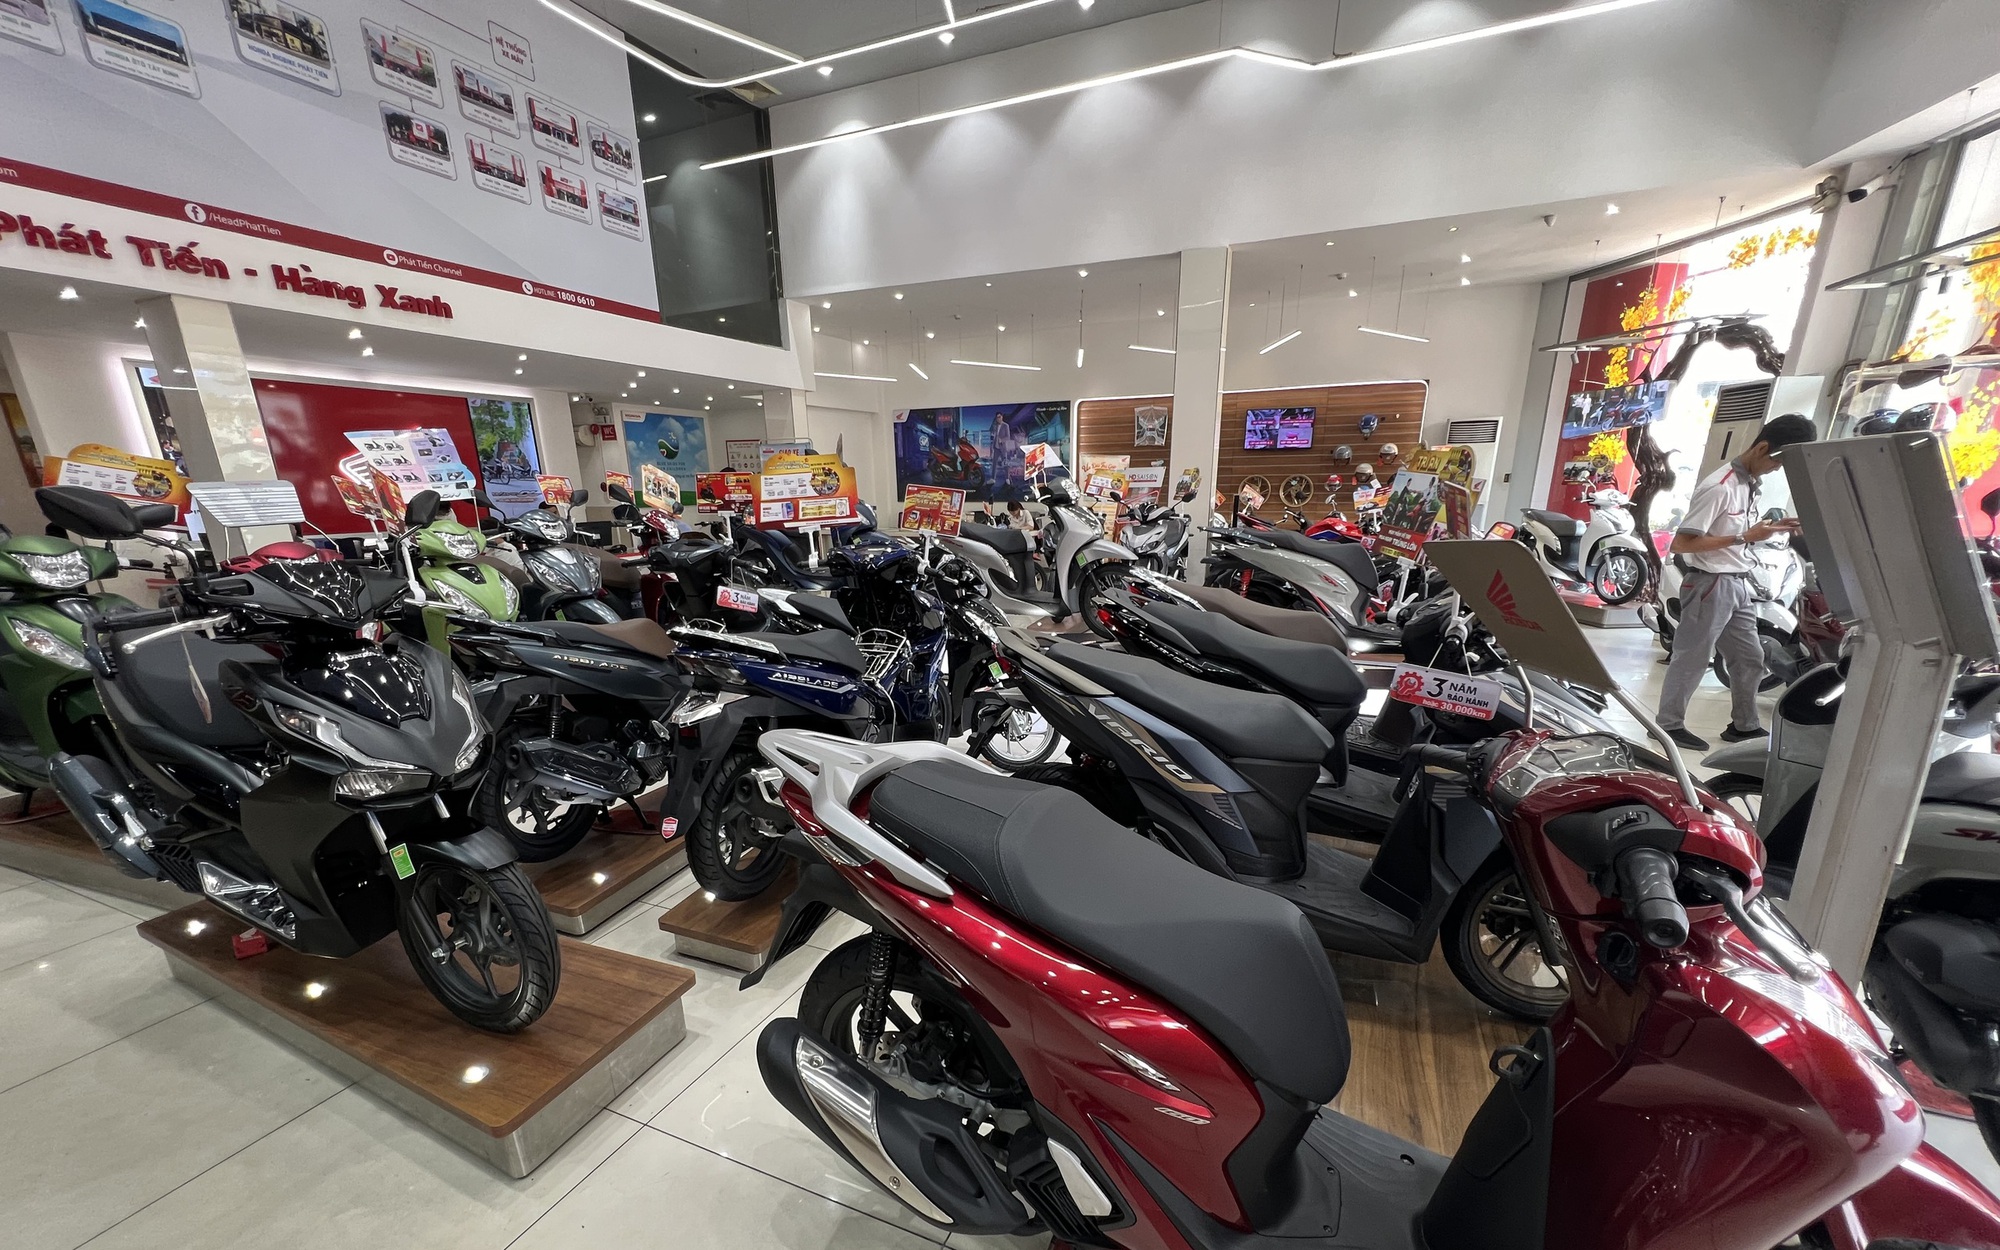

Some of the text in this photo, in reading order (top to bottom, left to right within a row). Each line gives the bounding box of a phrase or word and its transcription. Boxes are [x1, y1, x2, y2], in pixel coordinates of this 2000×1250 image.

[495, 36, 504, 46] HỆ
[209, 212, 281, 236] /HeadPhatTien
[399, 254, 462, 277] Phát Tiến Channel
[125, 235, 230, 280] Tiến
[271, 263, 366, 310] Hàng
[374, 284, 453, 319] Xanh
[556, 290, 576, 303] 1800
[576, 293, 595, 307] 6610
[603, 426, 614, 435] WC
[732, 592, 740, 603] 3
[772, 672, 839, 689] AIRBLADE
[1426, 677, 1478, 698] 3 NĂM
[1465, 695, 1489, 708] HÀNH
[1440, 702, 1486, 719] 30.000km
[1088, 703, 1193, 780] VARIO
